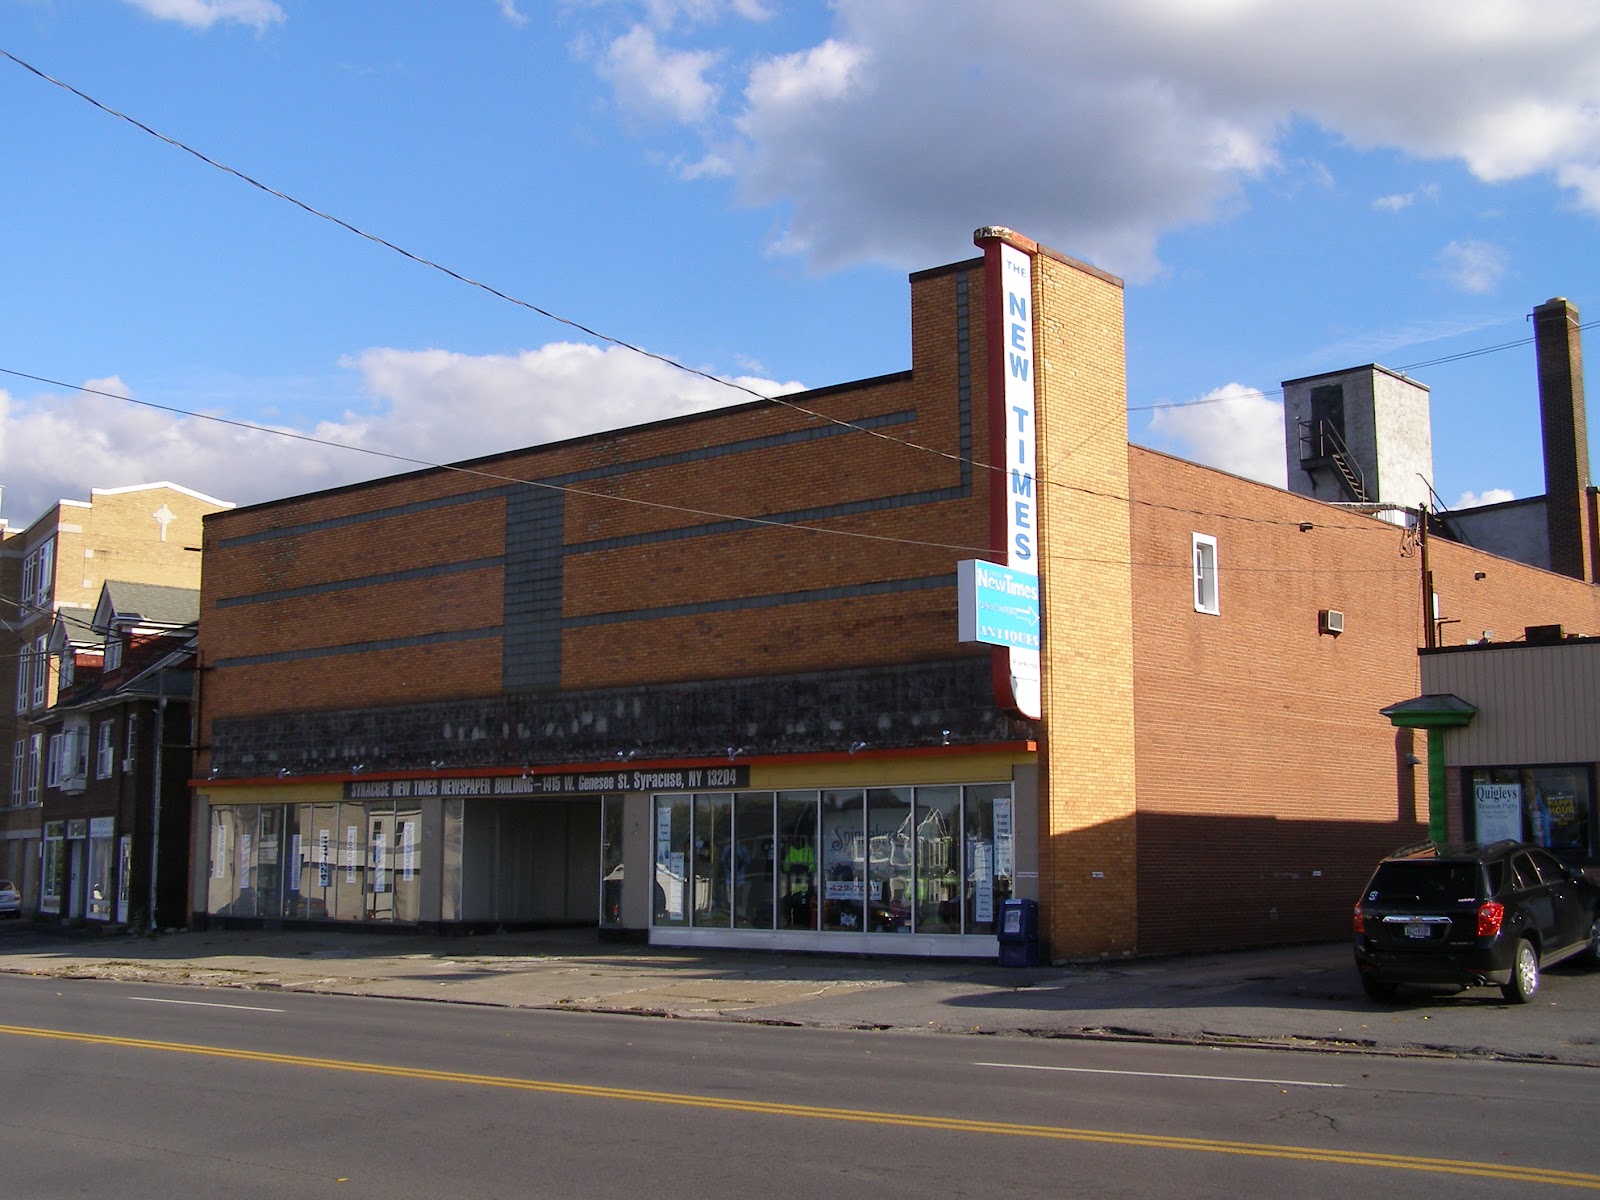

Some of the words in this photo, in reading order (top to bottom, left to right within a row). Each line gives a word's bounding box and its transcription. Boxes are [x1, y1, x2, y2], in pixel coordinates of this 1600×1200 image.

[1005, 259, 1027, 278] THE
[1008, 290, 1029, 382] NEW
[1011, 404, 1032, 561] TIMES
[980, 624, 1039, 647] ANTIQUES
[351, 781, 390, 797] SYRACUSE
[392, 781, 411, 796] NEW
[413, 779, 438, 796] TIMES
[440, 777, 491, 795] NEWSPAPER
[564, 776, 575, 791] W.
[578, 774, 615, 790] Genesee
[617, 773, 630, 789] St.
[633, 770, 685, 791] Syracuse,
[688, 770, 702, 787] NY
[706, 768, 737, 786] 13204
[1476, 786, 1517, 804] Quigleys
[1547, 799, 1574, 807] HAPPY
[1548, 805, 1575, 815] HOUR
